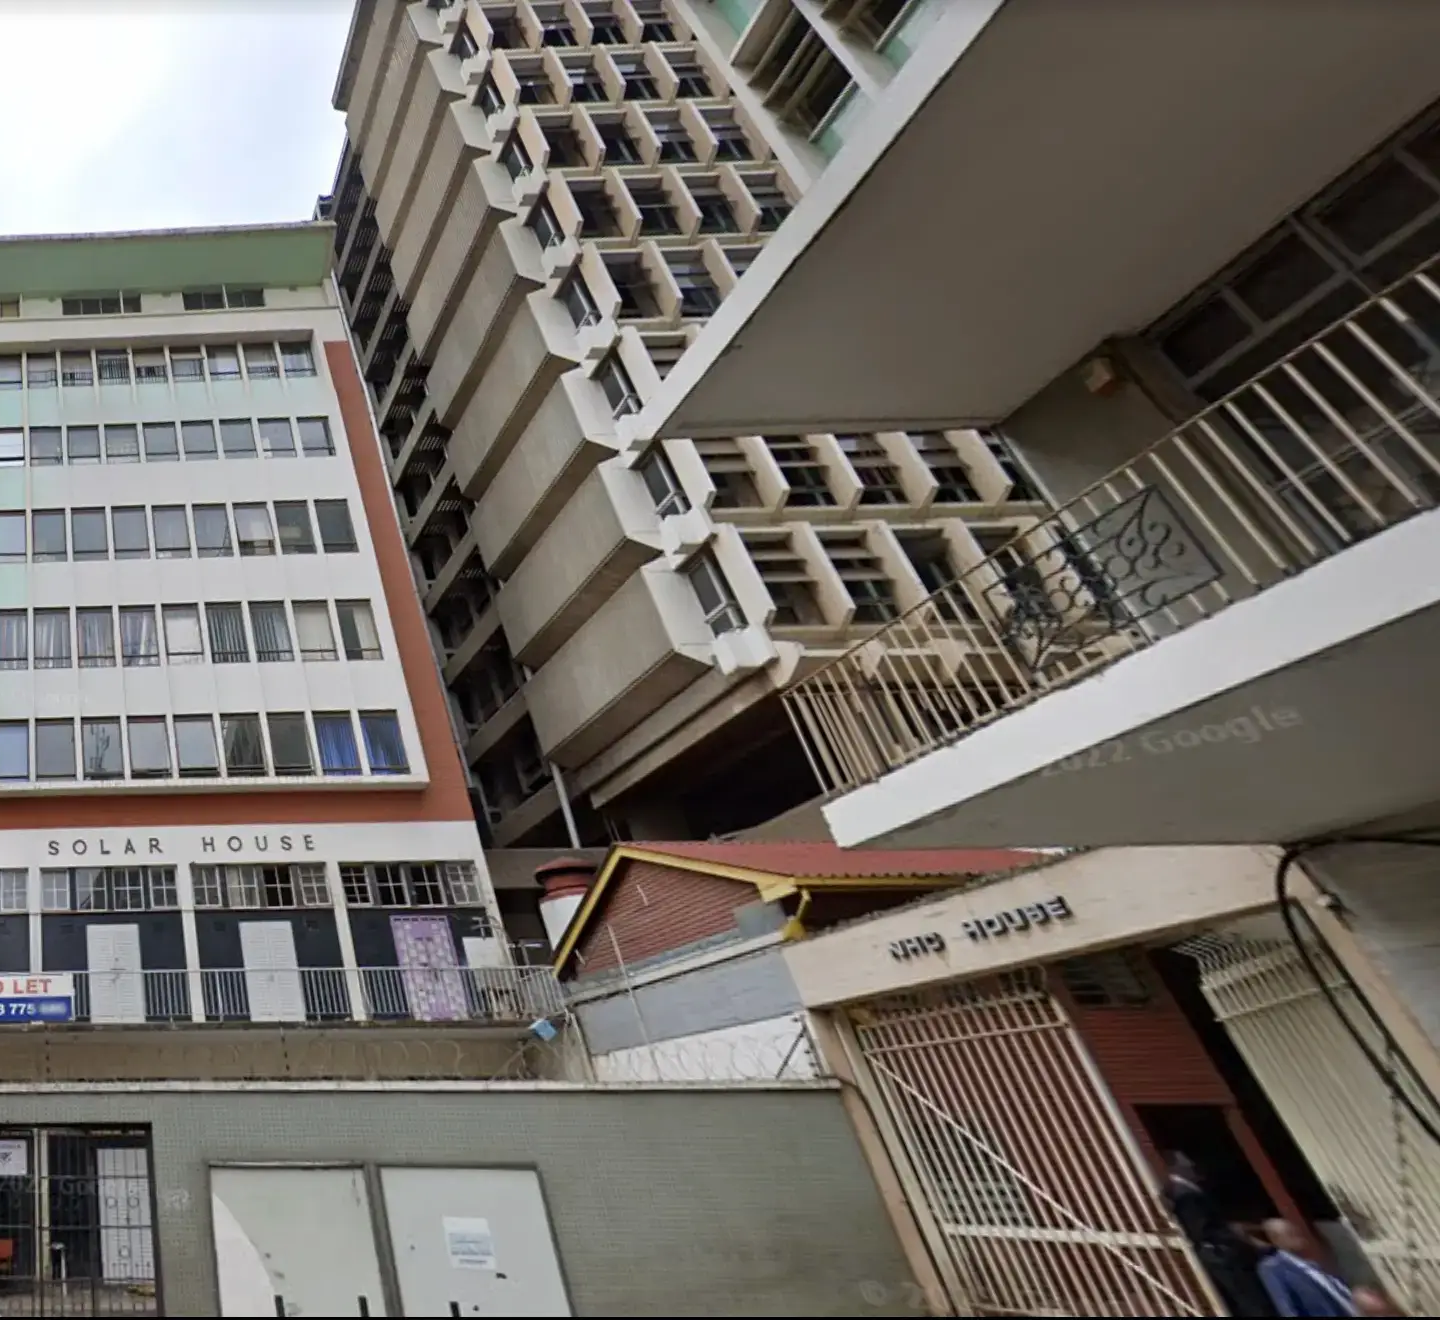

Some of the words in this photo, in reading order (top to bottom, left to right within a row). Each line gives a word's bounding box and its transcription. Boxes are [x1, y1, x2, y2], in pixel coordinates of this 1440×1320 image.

[48, 836, 163, 856] SOLAR
[202, 834, 315, 853] HOUSE
[961, 895, 1074, 943] HOUSE
[13, 978, 52, 995] LET
